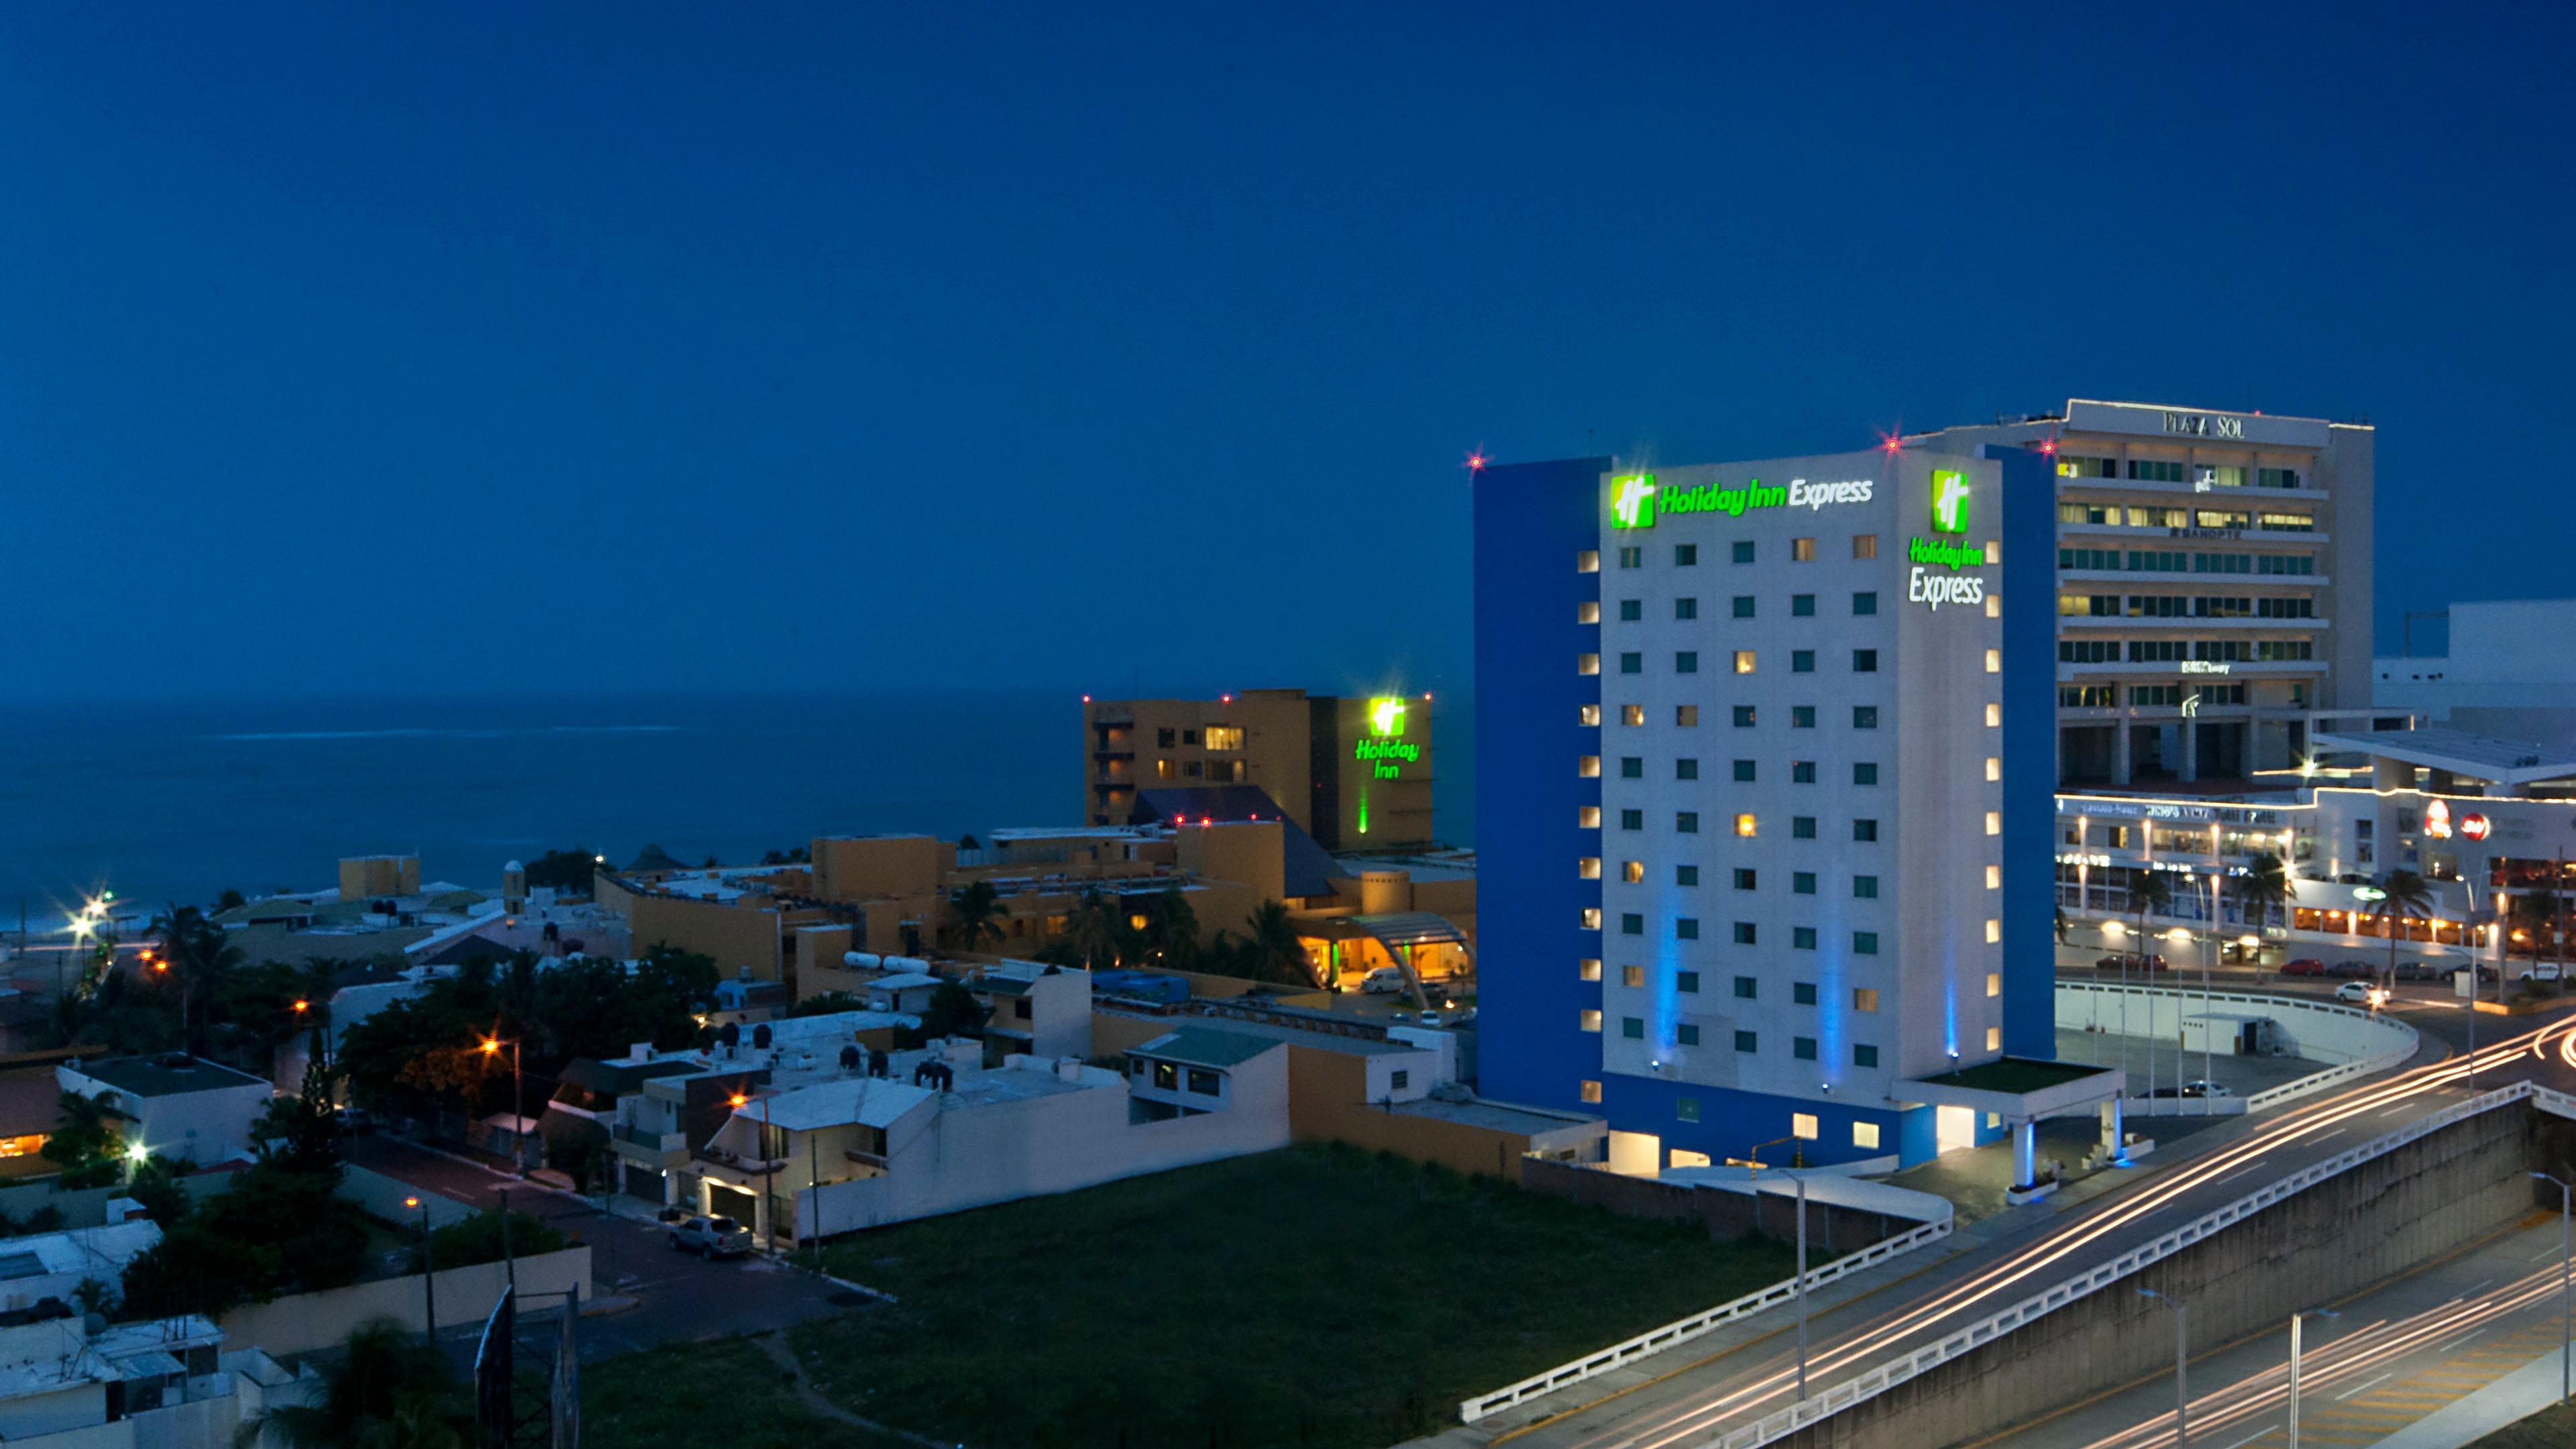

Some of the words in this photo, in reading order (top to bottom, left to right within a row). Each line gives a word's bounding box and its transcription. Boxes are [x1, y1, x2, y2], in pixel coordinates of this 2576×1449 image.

[2163, 411, 2210, 435] PLAZA
[2217, 416, 2245, 438] SOL
[1660, 483, 1747, 517] Holiday
[1748, 478, 1786, 508] Inn
[1788, 479, 1873, 510] Express
[1909, 537, 1962, 571] Holiday
[1962, 540, 1984, 566] Inn
[1909, 567, 1983, 611] Express
[1355, 739, 1420, 762] Holiday
[1374, 759, 1400, 779] Inn
